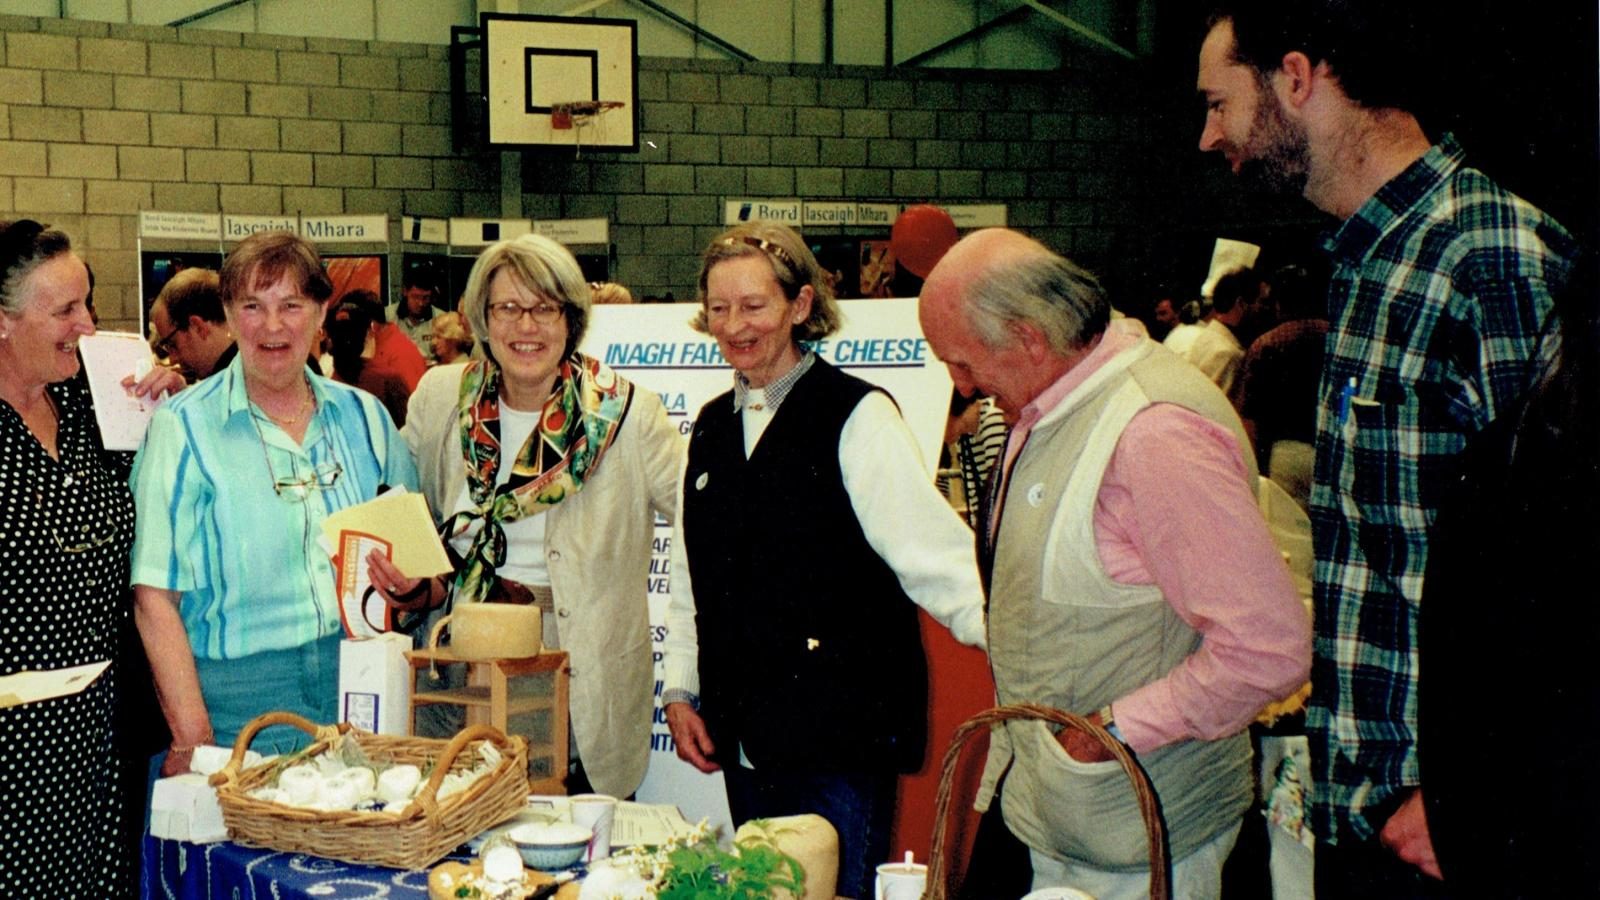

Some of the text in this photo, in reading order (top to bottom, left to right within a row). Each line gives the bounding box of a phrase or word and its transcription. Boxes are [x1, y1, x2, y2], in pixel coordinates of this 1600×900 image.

[758, 204, 889, 222] Bord Iascaigh Mhara
[306, 221, 365, 237] Mhara
[604, 342, 676, 365] INAGH
[834, 338, 927, 363] CHEESE
